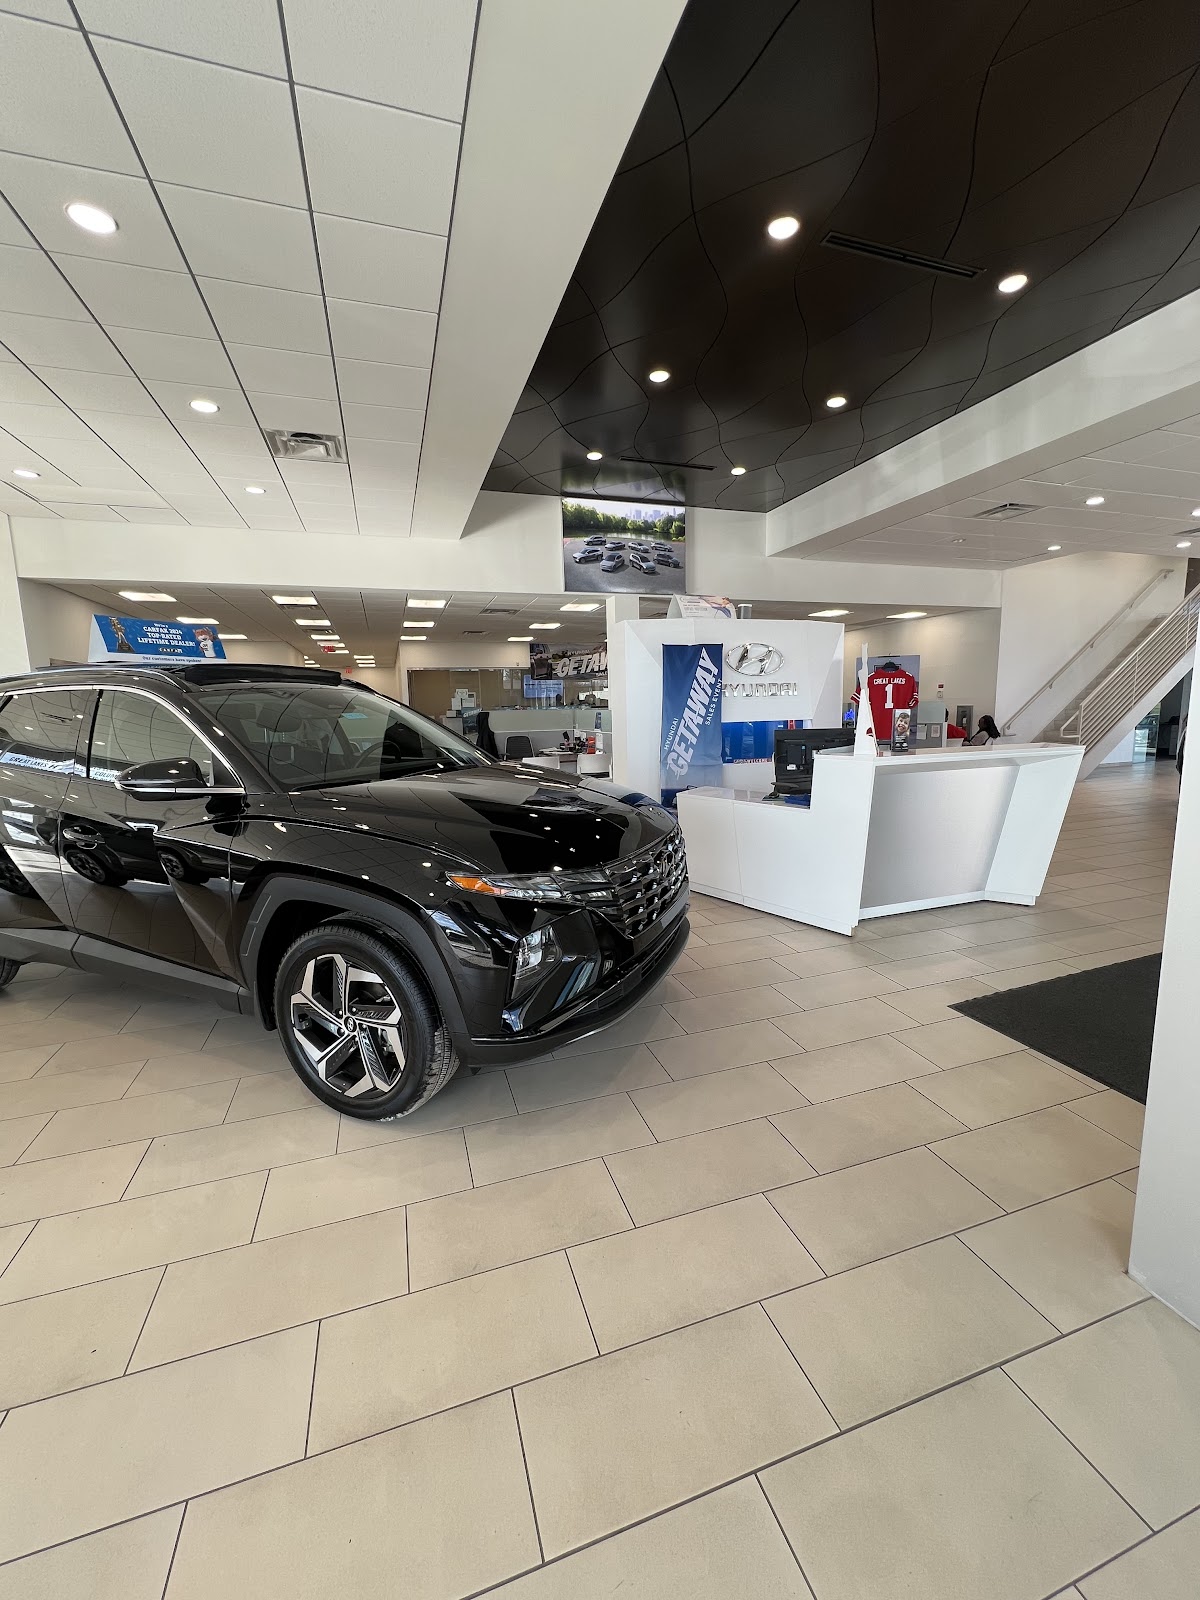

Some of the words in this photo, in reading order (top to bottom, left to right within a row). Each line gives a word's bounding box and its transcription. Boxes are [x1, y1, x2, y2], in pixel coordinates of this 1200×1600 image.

[143, 626, 169, 634] CARFAX
[146, 632, 182, 640] TOP-RATED
[137, 637, 170, 645] LIFETIME
[722, 682, 798, 697] HYUNDAI
[885, 683, 894, 709] 1
[705, 703, 716, 726] SALES
[713, 679, 723, 703] EVENT
[666, 646, 719, 780] GETAWAY
[663, 718, 679, 751] HYUNDAI
[9, 756, 31, 765] GREAT
[30, 760, 48, 768] LAKES
